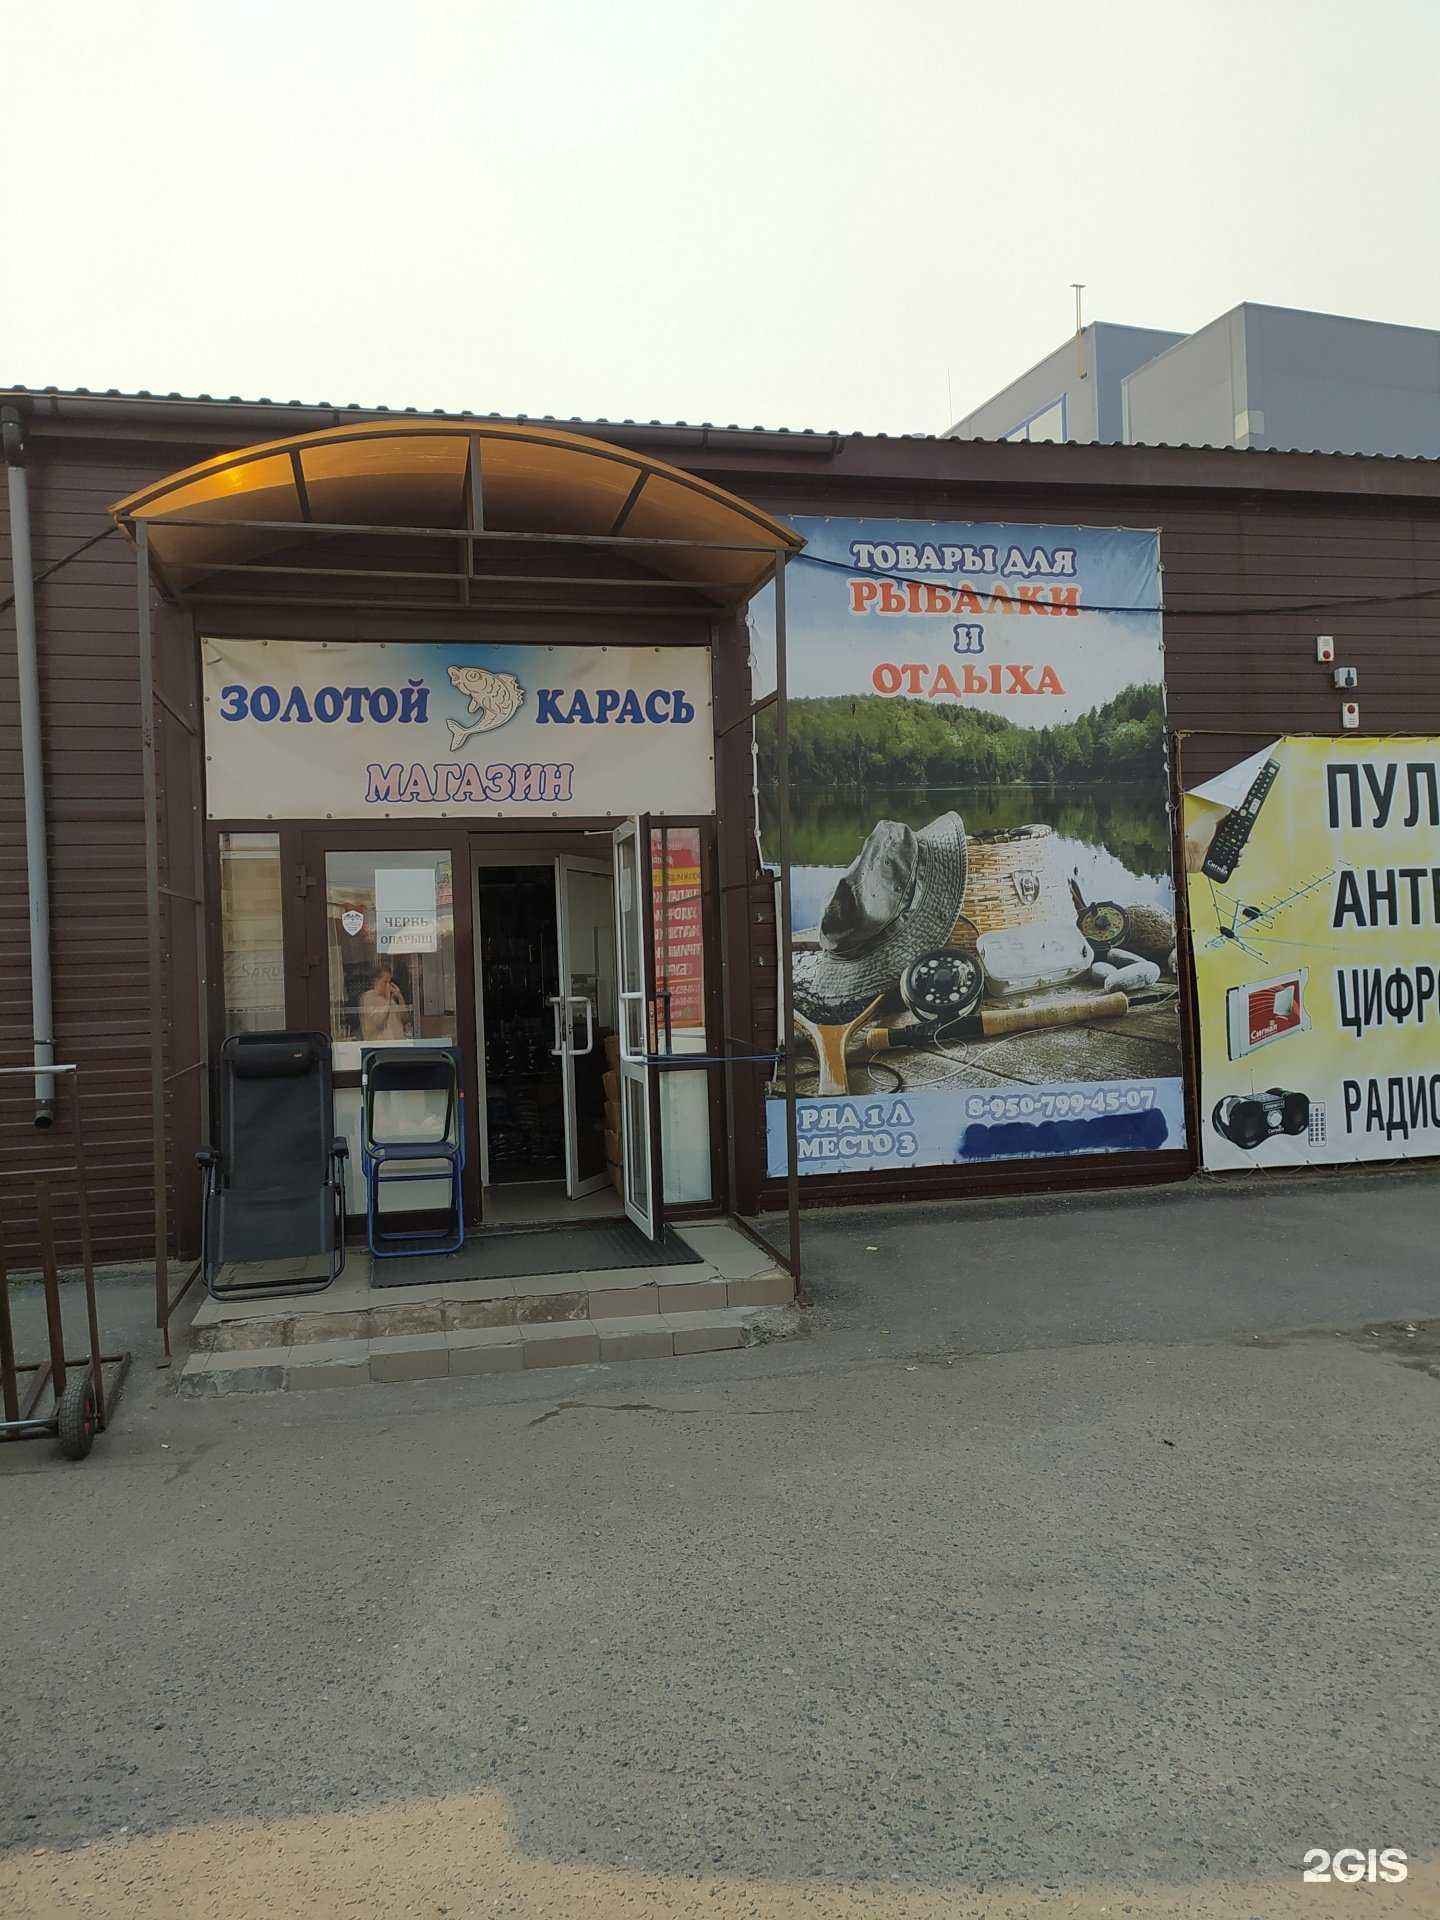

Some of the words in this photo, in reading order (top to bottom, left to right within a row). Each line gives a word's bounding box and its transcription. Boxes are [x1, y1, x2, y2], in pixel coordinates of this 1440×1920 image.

[851, 540, 998, 574] ТОВАРЫ
[1002, 546, 1079, 577] ДЛЯ
[850, 580, 1081, 616] РЫБАЛКИ
[954, 624, 983, 653] И
[871, 663, 1066, 698] ОТДЫХА
[219, 677, 430, 724] ЗОЛОТОЙ
[535, 688, 695, 725] КАРАСЬ
[365, 763, 575, 802] МАГАЗИН
[1337, 966, 1440, 1037] ЦИФР
[799, 1104, 861, 1131] РЯД
[967, 1087, 1156, 1120] 8-950-799-45-07
[798, 1132, 895, 1159] МЕСТО
[896, 1132, 919, 1157] 3
